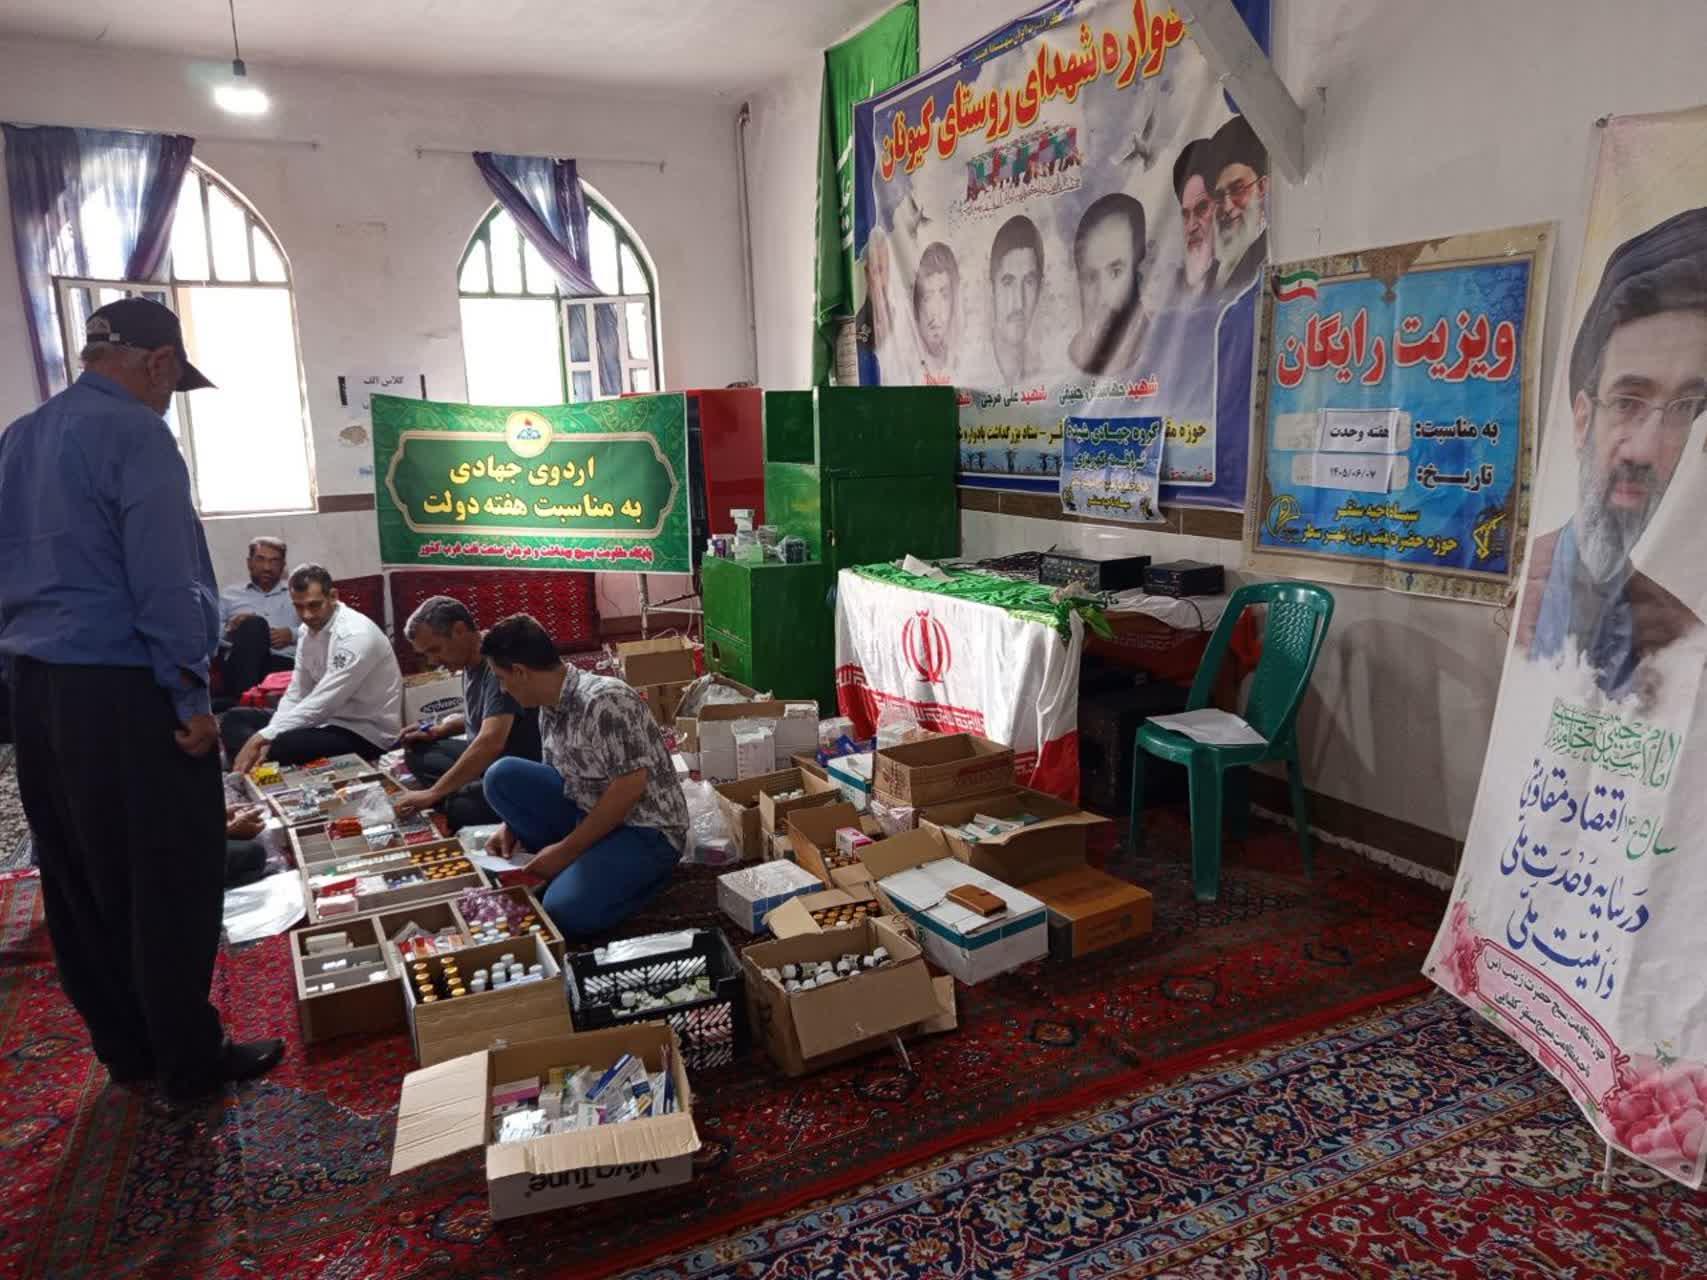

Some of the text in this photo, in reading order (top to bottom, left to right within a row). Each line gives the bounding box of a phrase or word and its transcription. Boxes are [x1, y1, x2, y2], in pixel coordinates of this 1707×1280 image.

[1015, 22, 1099, 128] شهدای
[936, 79, 1012, 160] روستای
[1276, 307, 1515, 388] ویزیت رایگان
[1020, 384, 1048, 406] شهید
[1090, 421, 1132, 446] جهادی
[1131, 420, 1160, 447] گروه
[1329, 425, 1390, 442] هفته وحدت
[1414, 415, 1500, 446] به مناسبت:
[450, 454, 597, 487] اردوی جهادی
[423, 489, 643, 524] به مناسبت هفته دولت
[1425, 535, 1458, 557] حوزه
[1559, 783, 1628, 842] اقتصاد
[1625, 812, 1678, 862] سال
[1615, 888, 1650, 933] در
